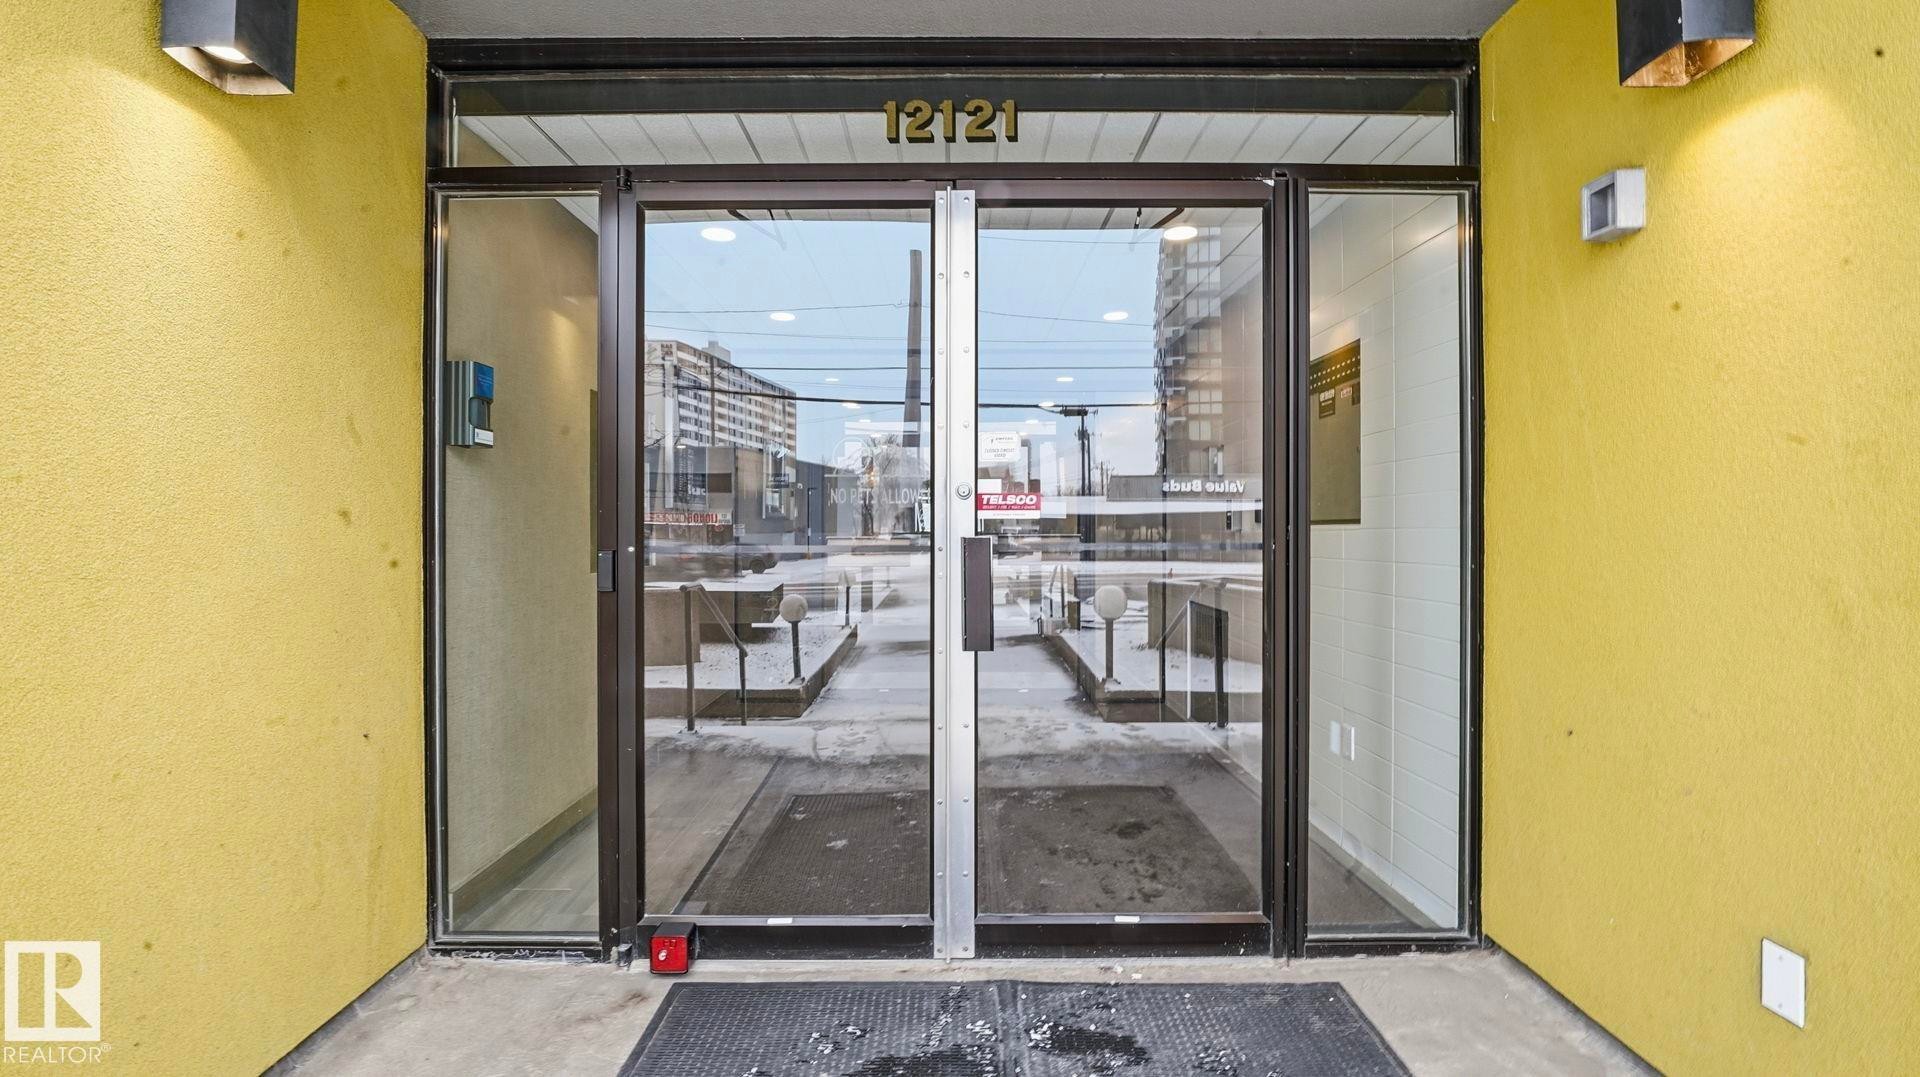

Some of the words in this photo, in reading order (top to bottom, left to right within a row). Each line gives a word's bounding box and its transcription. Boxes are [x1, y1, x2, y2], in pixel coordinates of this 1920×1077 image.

[883, 98, 1018, 143] 12121
[830, 488, 847, 504] NO
[850, 488, 877, 504] PETS
